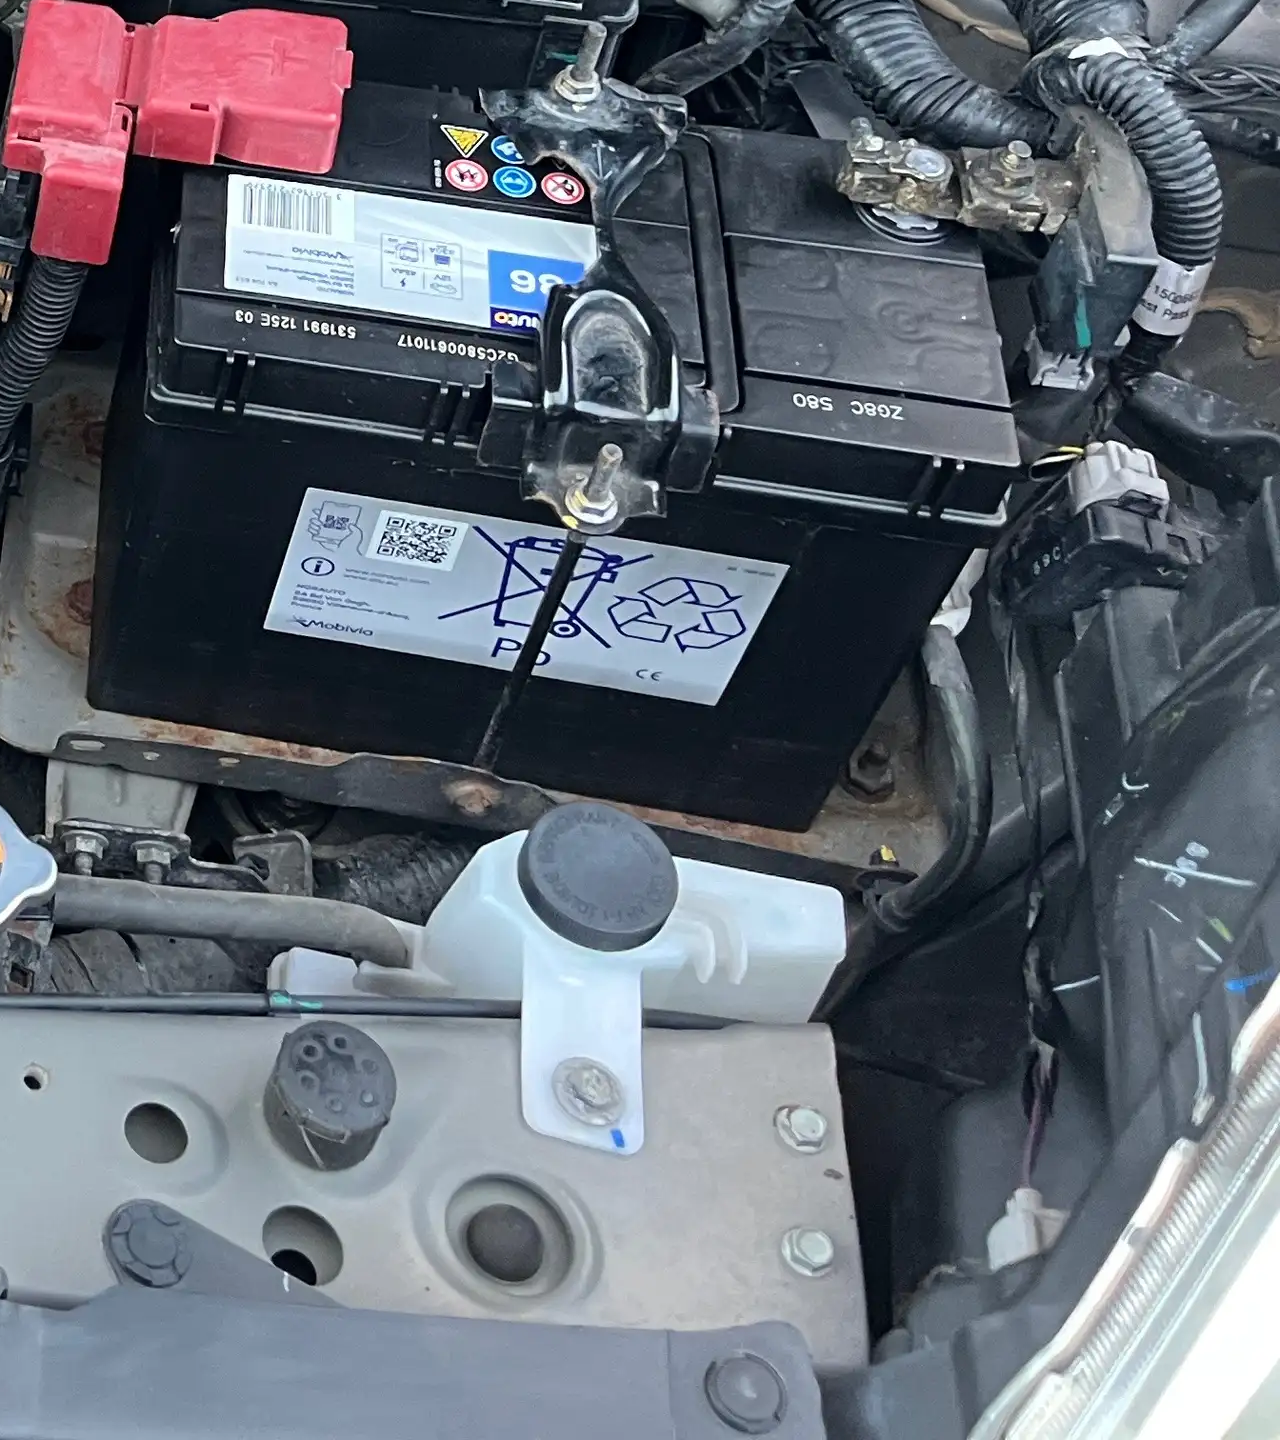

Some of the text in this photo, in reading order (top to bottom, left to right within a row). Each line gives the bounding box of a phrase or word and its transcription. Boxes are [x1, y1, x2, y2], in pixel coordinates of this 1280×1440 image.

[292, 246, 338, 259] Mobivia
[235, 309, 254, 324] 03
[260, 312, 297, 330] 125E
[792, 392, 905, 421] ZG8C 580
[309, 619, 374, 636] Mobivia
